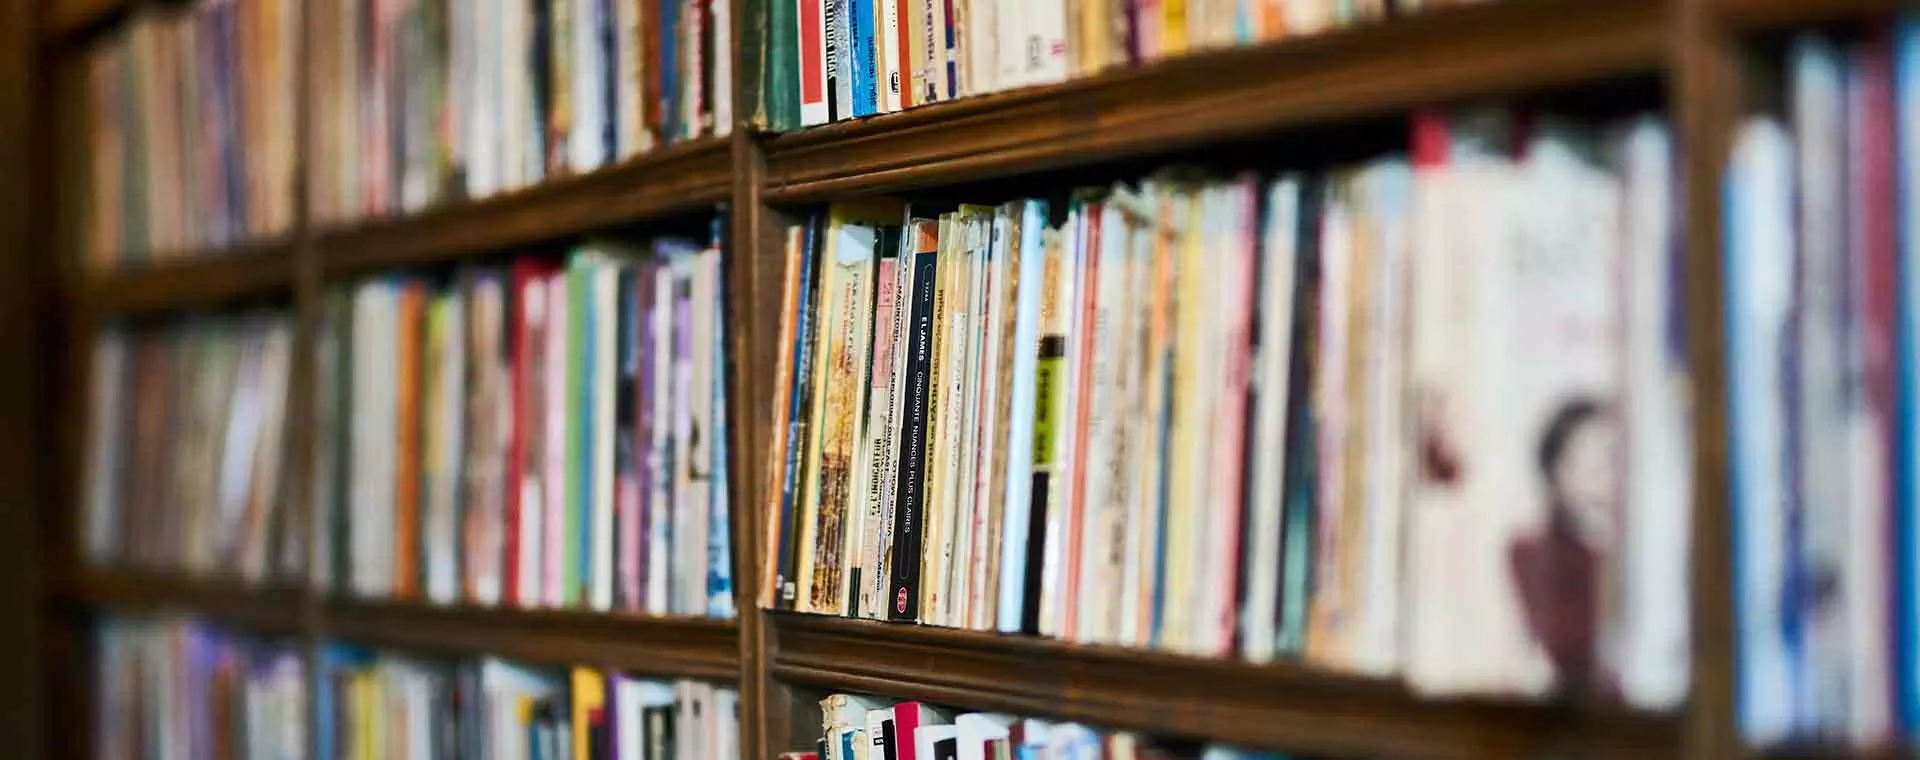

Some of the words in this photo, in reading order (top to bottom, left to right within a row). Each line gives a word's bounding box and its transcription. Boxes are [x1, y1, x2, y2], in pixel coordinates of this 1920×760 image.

[894, 286, 902, 341] MACINTOSH
[918, 329, 927, 361] JAMES
[913, 371, 923, 423] CINQUANTE
[909, 425, 919, 468] NUANCES
[907, 470, 916, 494] PLUS
[904, 496, 913, 534] CLAIRES
